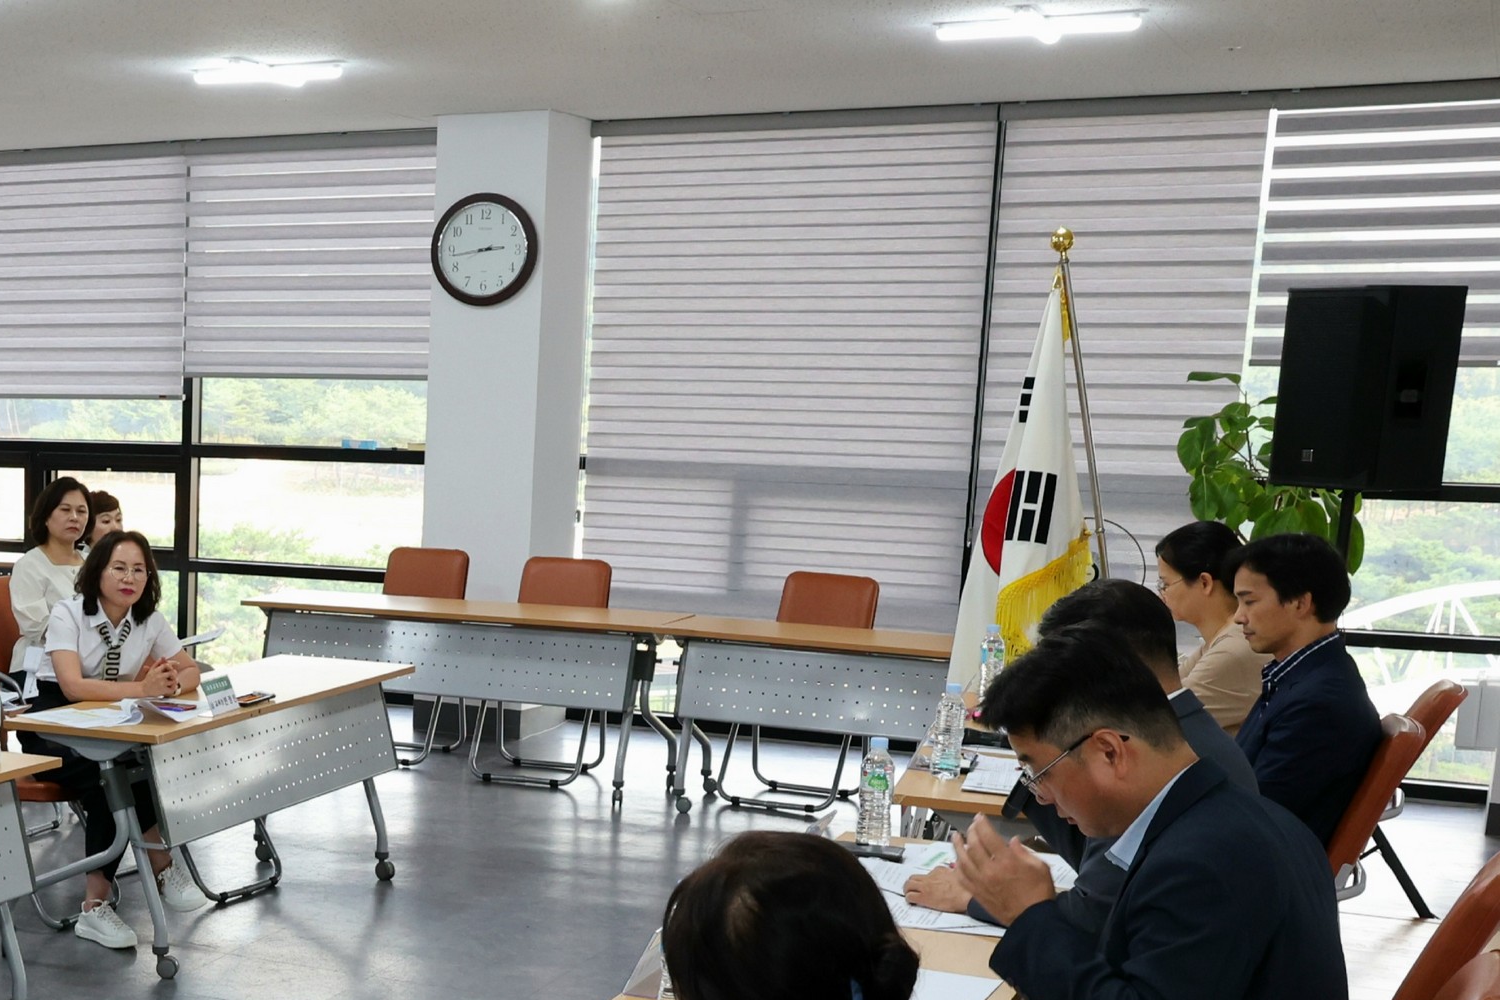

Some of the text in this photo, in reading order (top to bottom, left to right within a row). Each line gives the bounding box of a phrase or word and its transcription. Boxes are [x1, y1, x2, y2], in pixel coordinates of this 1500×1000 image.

[465, 214, 473, 225] 11
[481, 209, 492, 220] 12
[453, 226, 462, 237] 10
[510, 225, 518, 237] 2
[448, 246, 455, 257] 9
[514, 243, 521, 255] 3
[452, 262, 459, 272] 8
[508, 262, 515, 272] 4
[464, 276, 471, 288] 7
[479, 280, 487, 291] 6
[496, 275, 503, 287] 5
